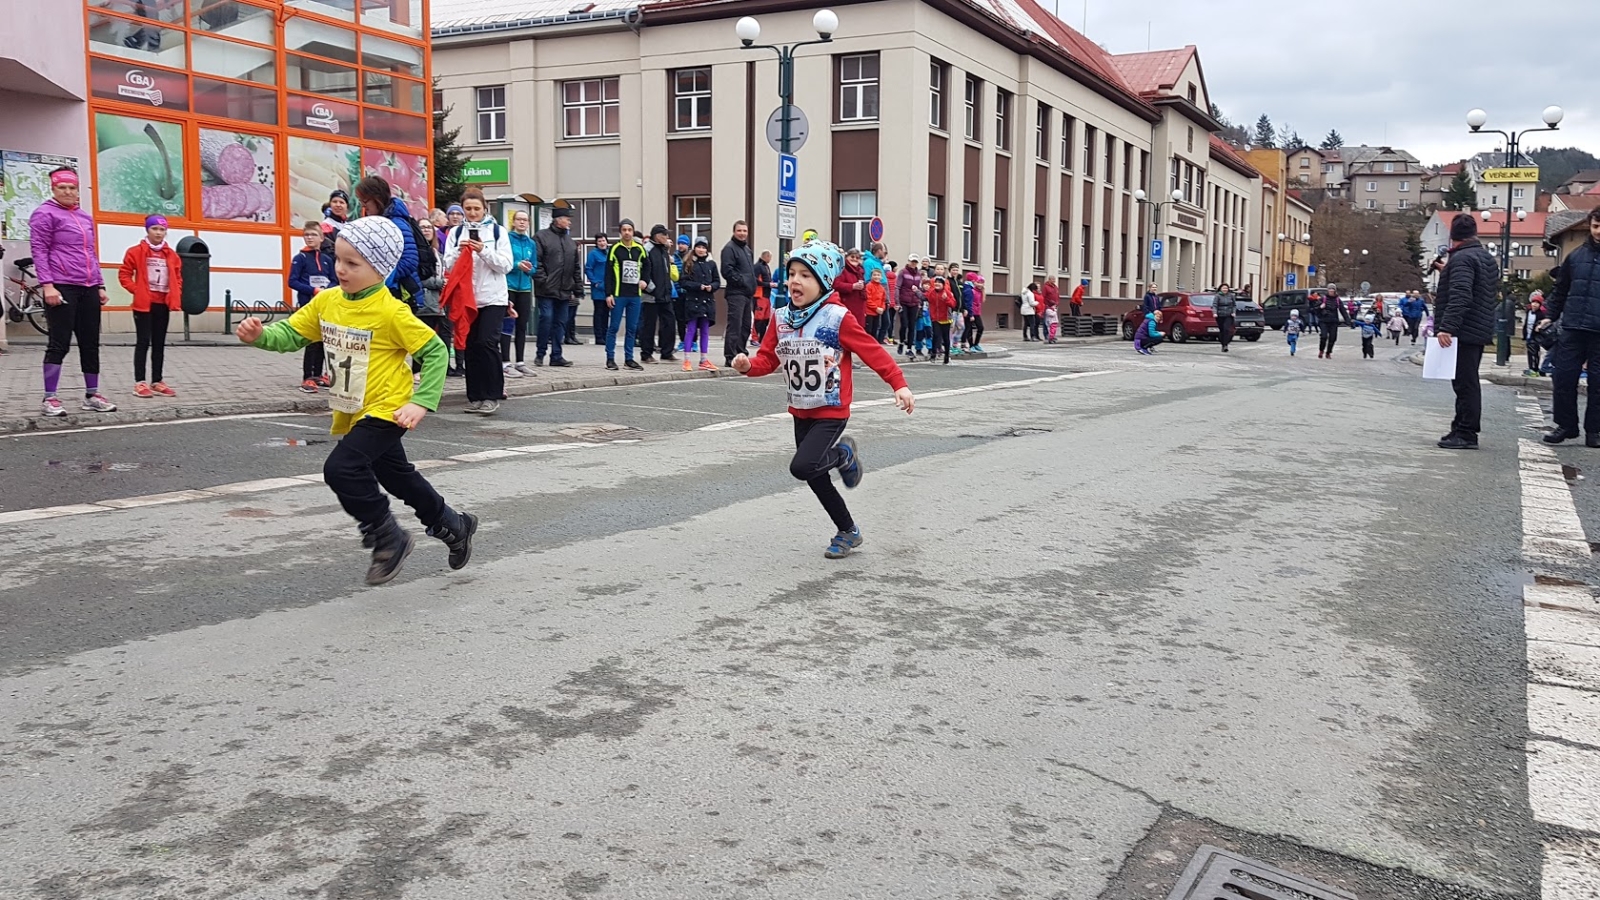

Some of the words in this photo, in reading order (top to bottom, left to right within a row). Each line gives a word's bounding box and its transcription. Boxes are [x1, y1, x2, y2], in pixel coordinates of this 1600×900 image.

[130, 74, 150, 87] CBA
[315, 107, 330, 117] CBA
[463, 167, 492, 176] Lékárna
[782, 159, 794, 187] P
[1488, 170, 1521, 179] VEŘEJNÉ
[1153, 242, 1161, 254] P
[155, 269, 161, 284] 7
[623, 267, 639, 279] 235
[1287, 274, 1294, 282] P
[345, 341, 367, 352] LIGA
[803, 347, 821, 355] LIGA
[326, 351, 352, 392] 51
[783, 359, 822, 391] 135
